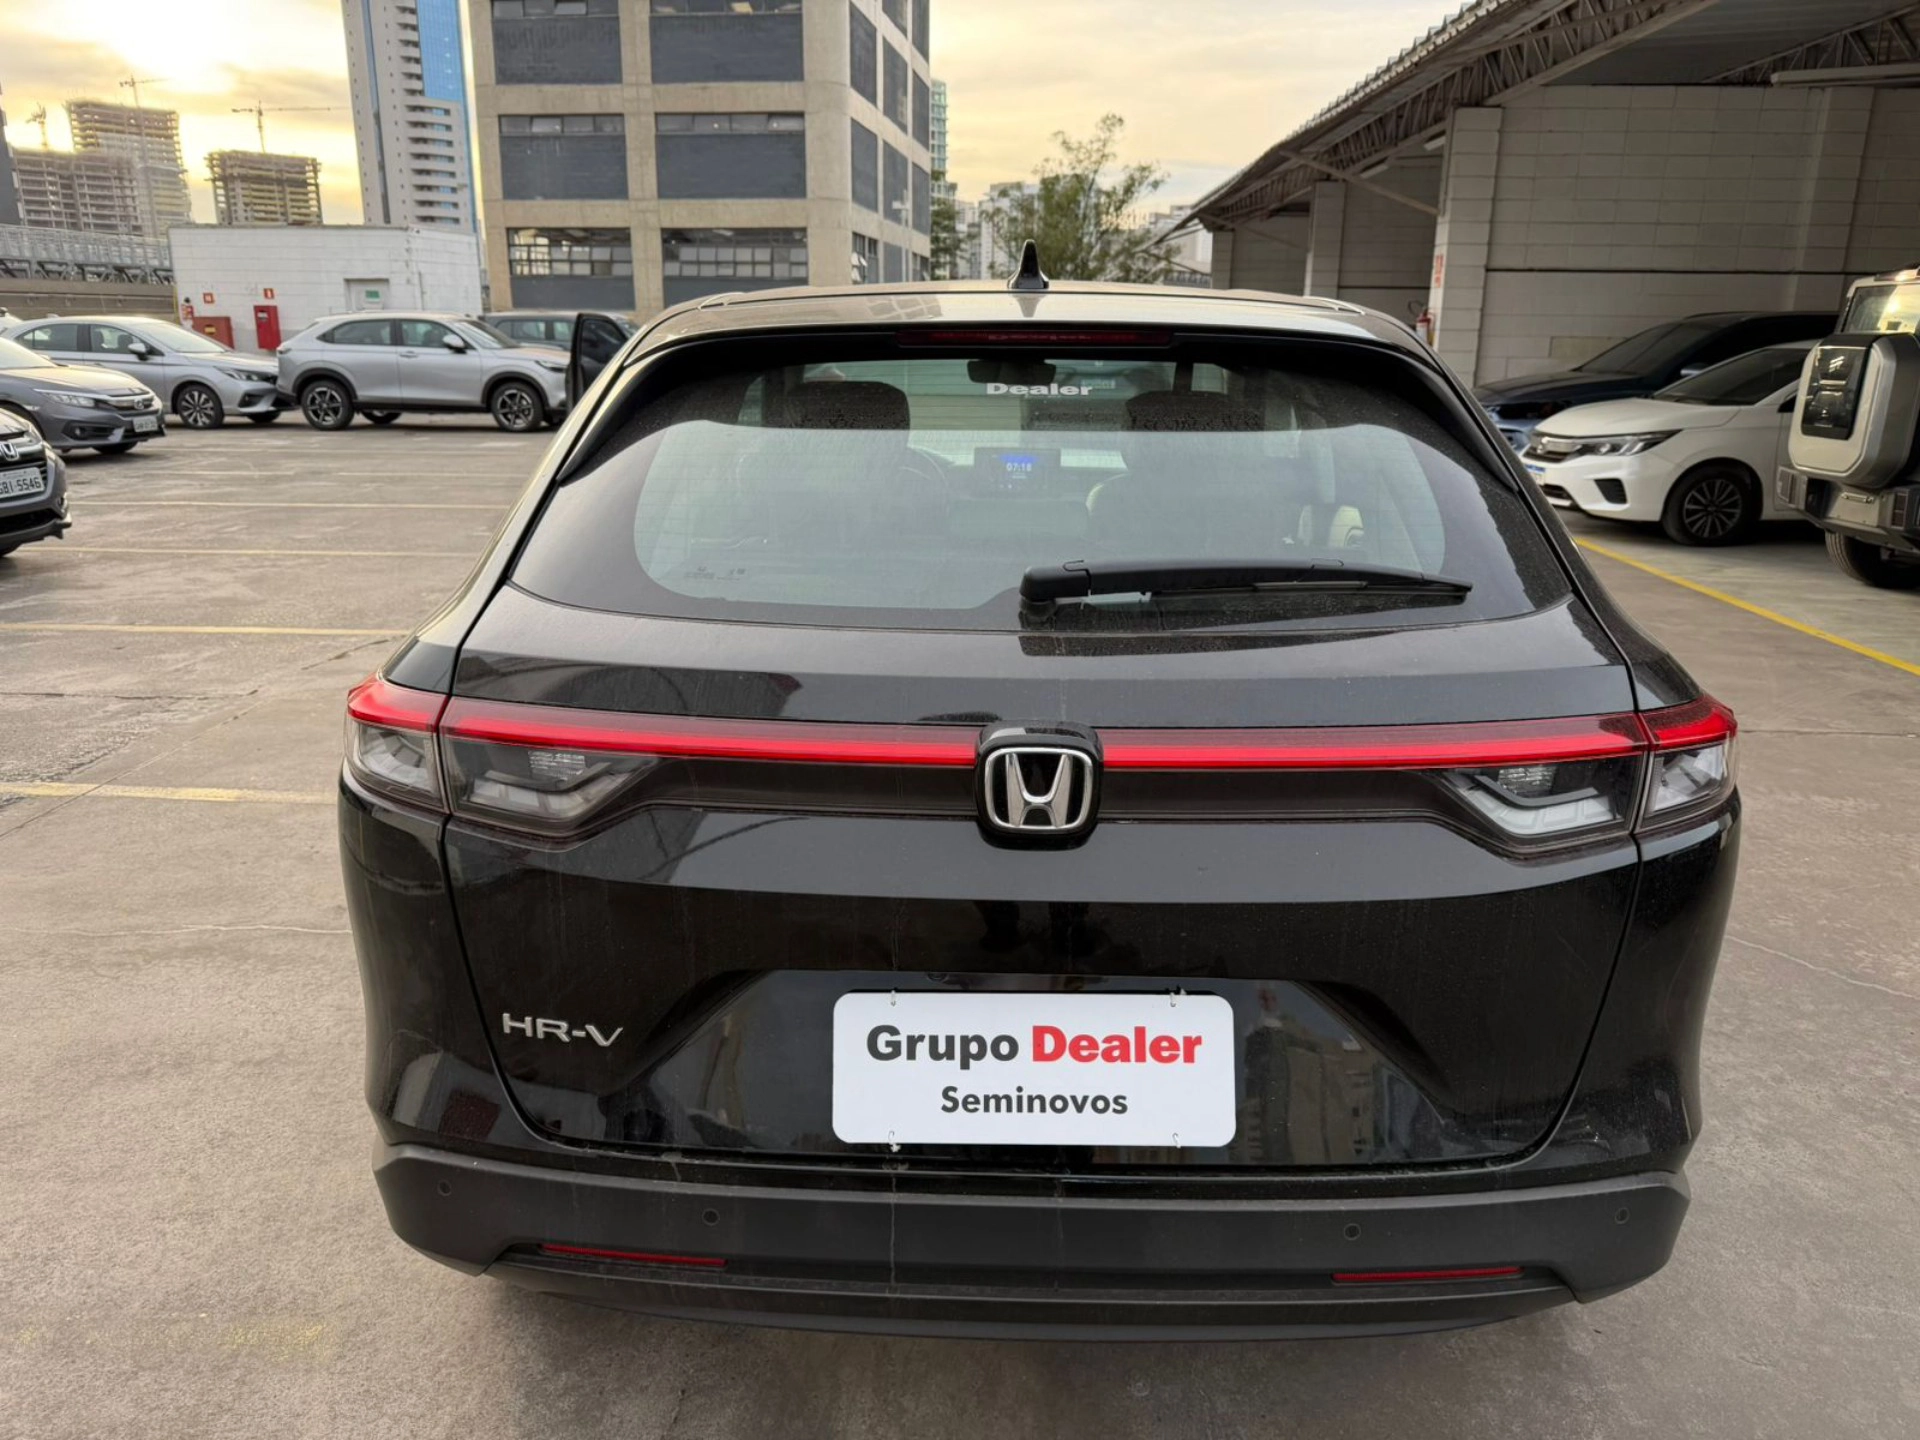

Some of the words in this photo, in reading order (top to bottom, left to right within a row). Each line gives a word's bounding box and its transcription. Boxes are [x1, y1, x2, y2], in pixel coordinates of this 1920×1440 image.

[986, 382, 1093, 396] Dealer
[502, 1012, 624, 1047] HR-V
[866, 1024, 1020, 1070] Grupo
[1032, 1025, 1203, 1064] Dealer
[940, 1085, 1129, 1115] Seminovos
